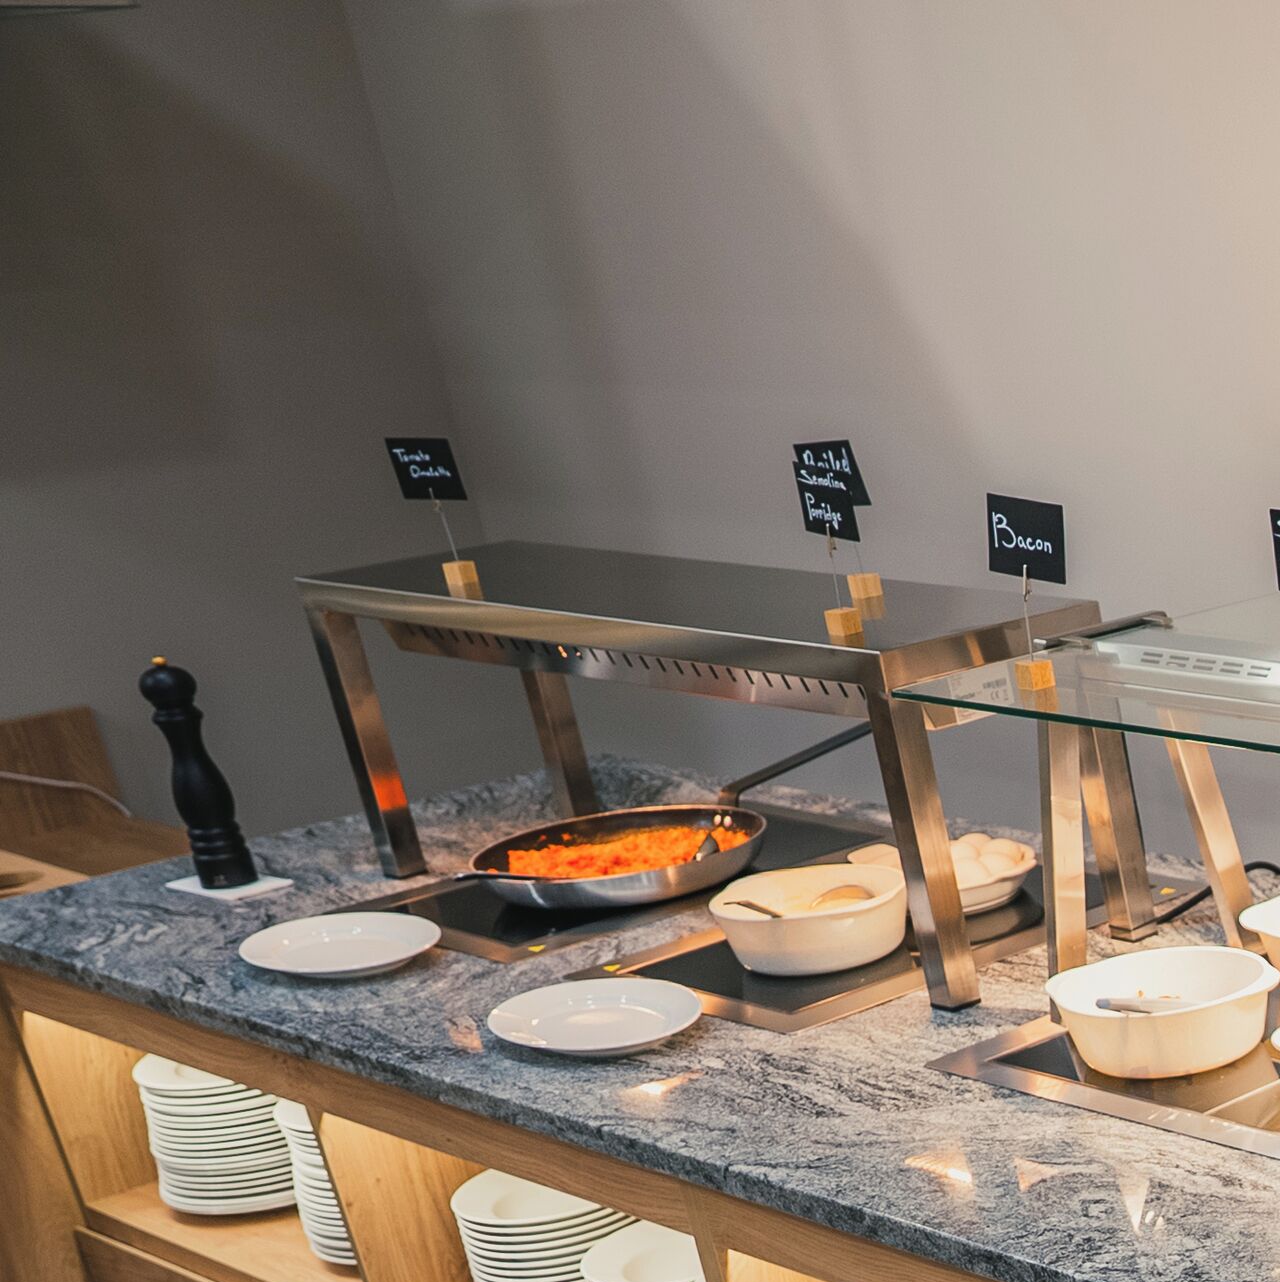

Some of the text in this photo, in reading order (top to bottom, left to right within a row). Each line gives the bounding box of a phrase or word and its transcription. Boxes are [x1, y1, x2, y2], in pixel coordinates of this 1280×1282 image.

[797, 469, 847, 490] Semolina
[804, 491, 843, 530] Porridge
[991, 511, 1054, 555] Bacon
